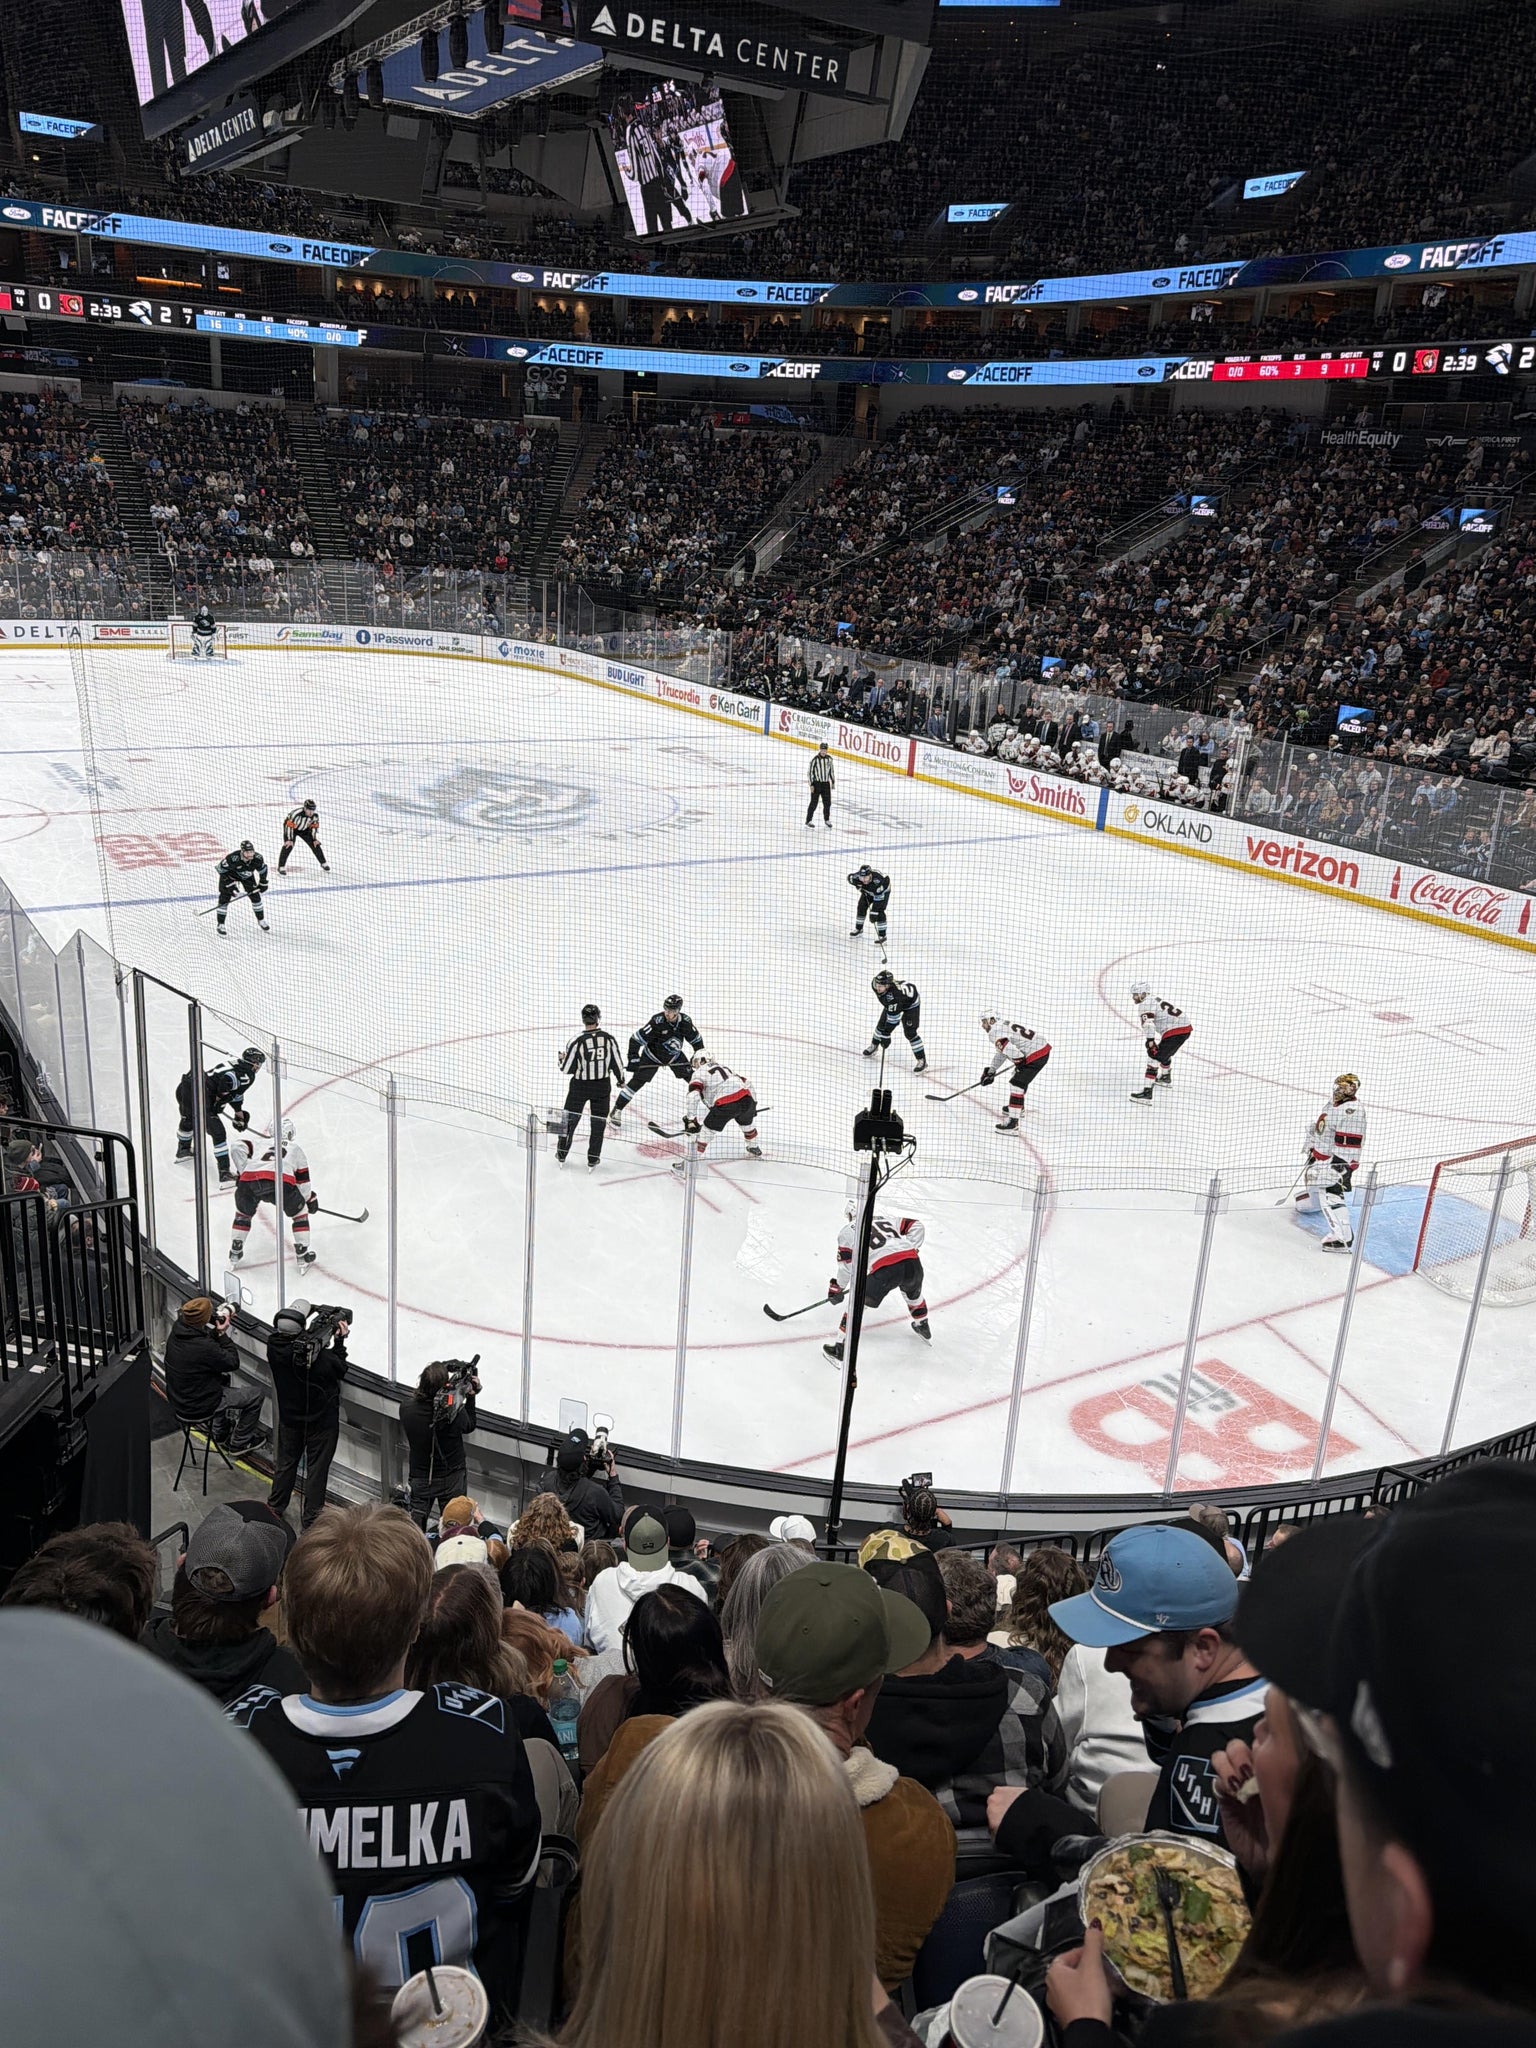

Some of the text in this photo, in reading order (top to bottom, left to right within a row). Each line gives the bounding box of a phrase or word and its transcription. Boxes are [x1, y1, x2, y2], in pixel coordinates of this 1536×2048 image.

[626, 12, 840, 84] DELTA CENTER
[193, 107, 257, 156] DELTA CENTER
[42, 207, 122, 234] FACEOFF
[302, 243, 370, 266] FACEOFF
[1419, 240, 1505, 270] FACEOFF
[543, 271, 609, 291] FACEOFF
[1178, 266, 1239, 290] FACEOFF
[16, 297, 24, 307] 4
[38, 293, 51, 310] 0
[766, 286, 830, 303] FACEOFF
[985, 283, 1044, 304] FACEOFF
[90, 303, 122, 319] 2:39
[160, 307, 171, 324] 2
[185, 315, 192, 325] 7
[210, 319, 222, 329] 16
[238, 323, 244, 332] 3
[287, 327, 308, 339] 40%
[326, 332, 341, 342] 0/0
[358, 329, 368, 345] F
[539, 348, 604, 365] FACEOFF
[1393, 352, 1406, 372] 0
[1443, 355, 1477, 371] 2:39
[1519, 347, 1535, 368] 2
[759, 361, 821, 379] FACEOFF
[975, 366, 1033, 382] FACEOFF
[1228, 366, 1243, 377] 0/0
[1259, 365, 1279, 376] 60%
[1294, 365, 1301, 375] 3
[1321, 363, 1328, 374] 9
[1344, 363, 1355, 374] 11
[1373, 361, 1380, 371] 4
[526, 365, 568, 385] G2G
[1320, 430, 1401, 449] HealthEquity
[14, 626, 81, 638] DELTA
[100, 627, 131, 636] SME
[292, 630, 343, 640] SameDay
[373, 632, 433, 647] 1Password
[513, 644, 545, 658] moxie
[607, 666, 645, 687] BUD LIGHT
[661, 681, 700, 705] Trucordia
[717, 695, 760, 721] Ken Garff
[1029, 775, 1086, 815] Smith's
[1143, 810, 1213, 844] OKLAND
[1246, 836, 1360, 889] verizon
[1409, 874, 1511, 925] Coca-Cola
[588, 1048, 605, 1061] 79
[1178, 1762, 1212, 1816] UTAH
[298, 1798, 473, 1870] MELKA
